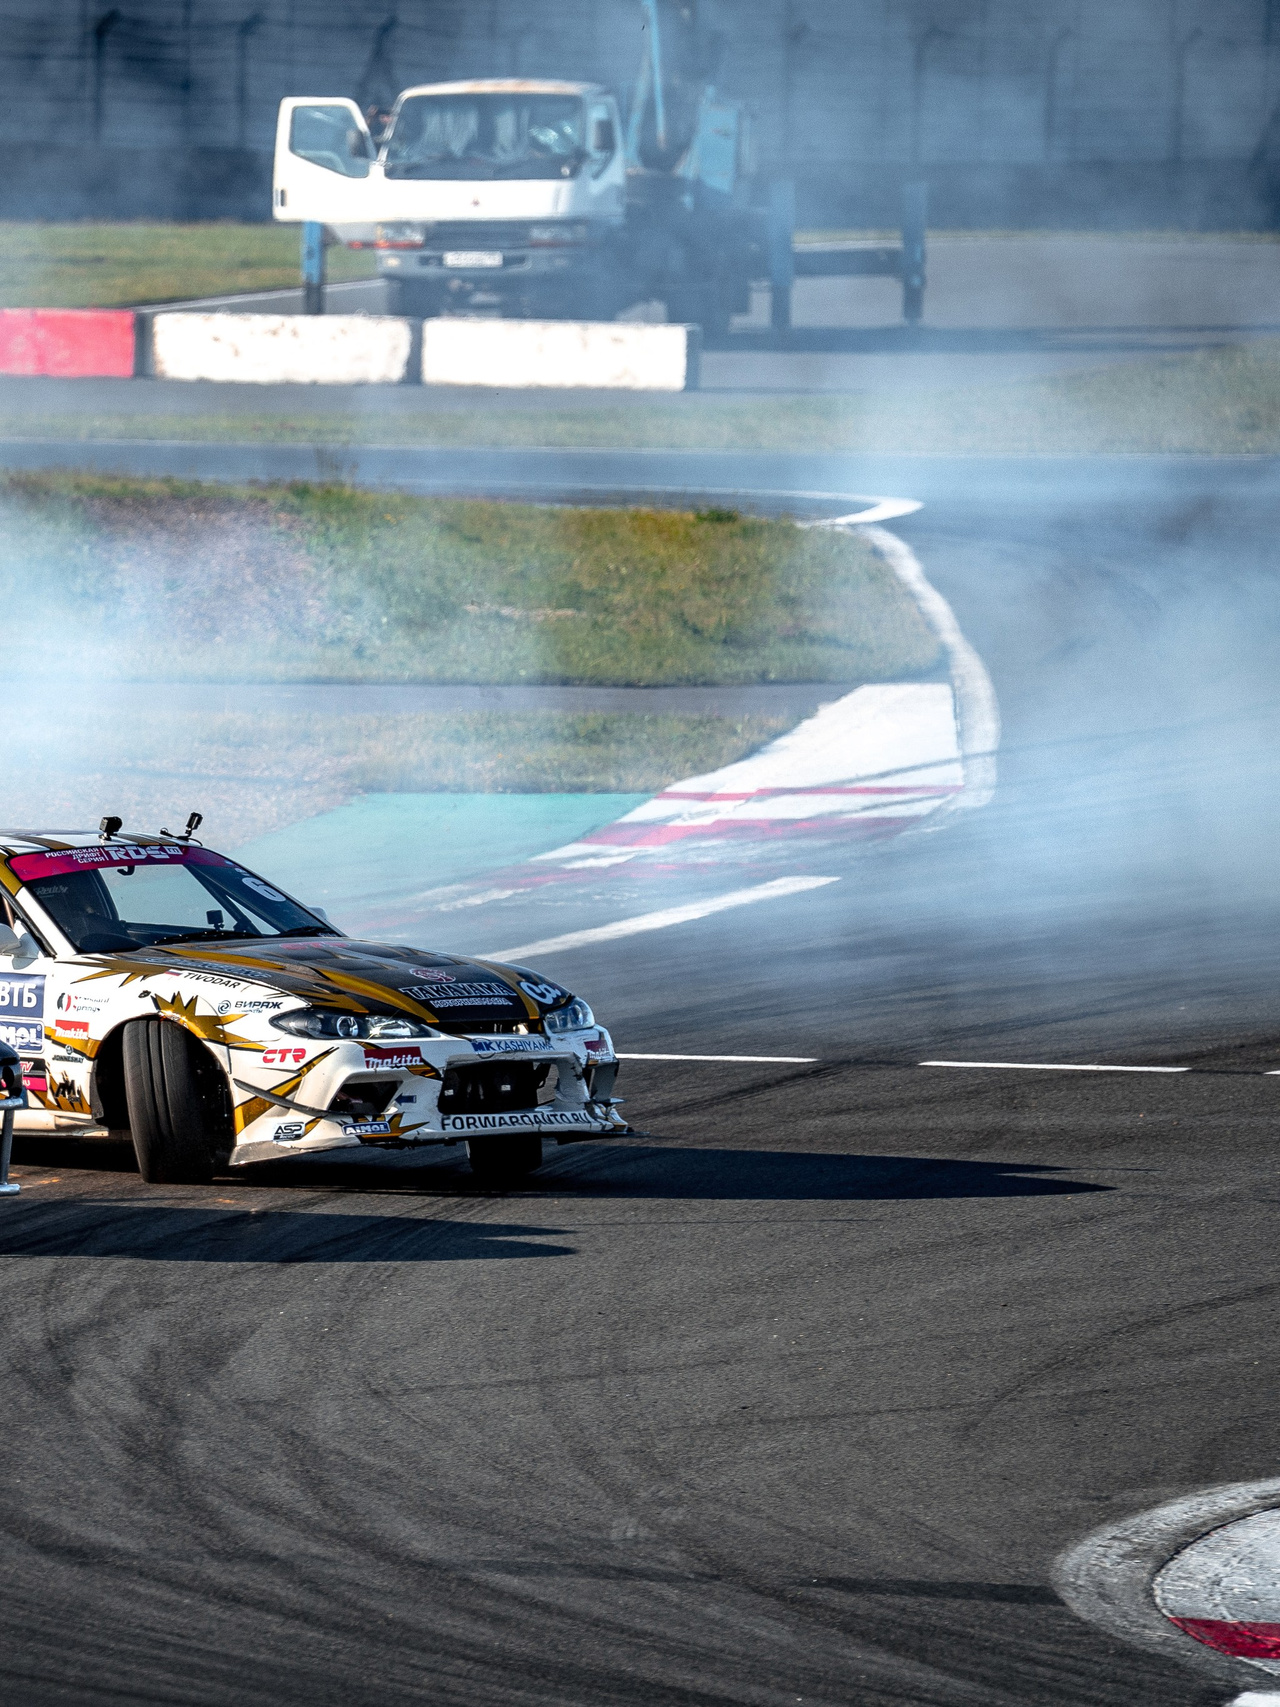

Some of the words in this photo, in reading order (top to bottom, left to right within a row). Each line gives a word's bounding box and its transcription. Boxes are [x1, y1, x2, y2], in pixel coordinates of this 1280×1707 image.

[44, 847, 100, 858] РОССИЙСКАЯ
[73, 851, 101, 860] ДРИФТ
[78, 856, 105, 864] СЕРИЯ
[183, 972, 242, 989] TIVODAR
[398, 982, 518, 1000] TAKAYAMA
[496, 1040, 556, 1052] KASHIYAMA
[262, 1047, 307, 1064] CTR
[364, 1054, 424, 1069] makita
[274, 1124, 303, 1135] ASP
[344, 1122, 389, 1135] AIMOL
